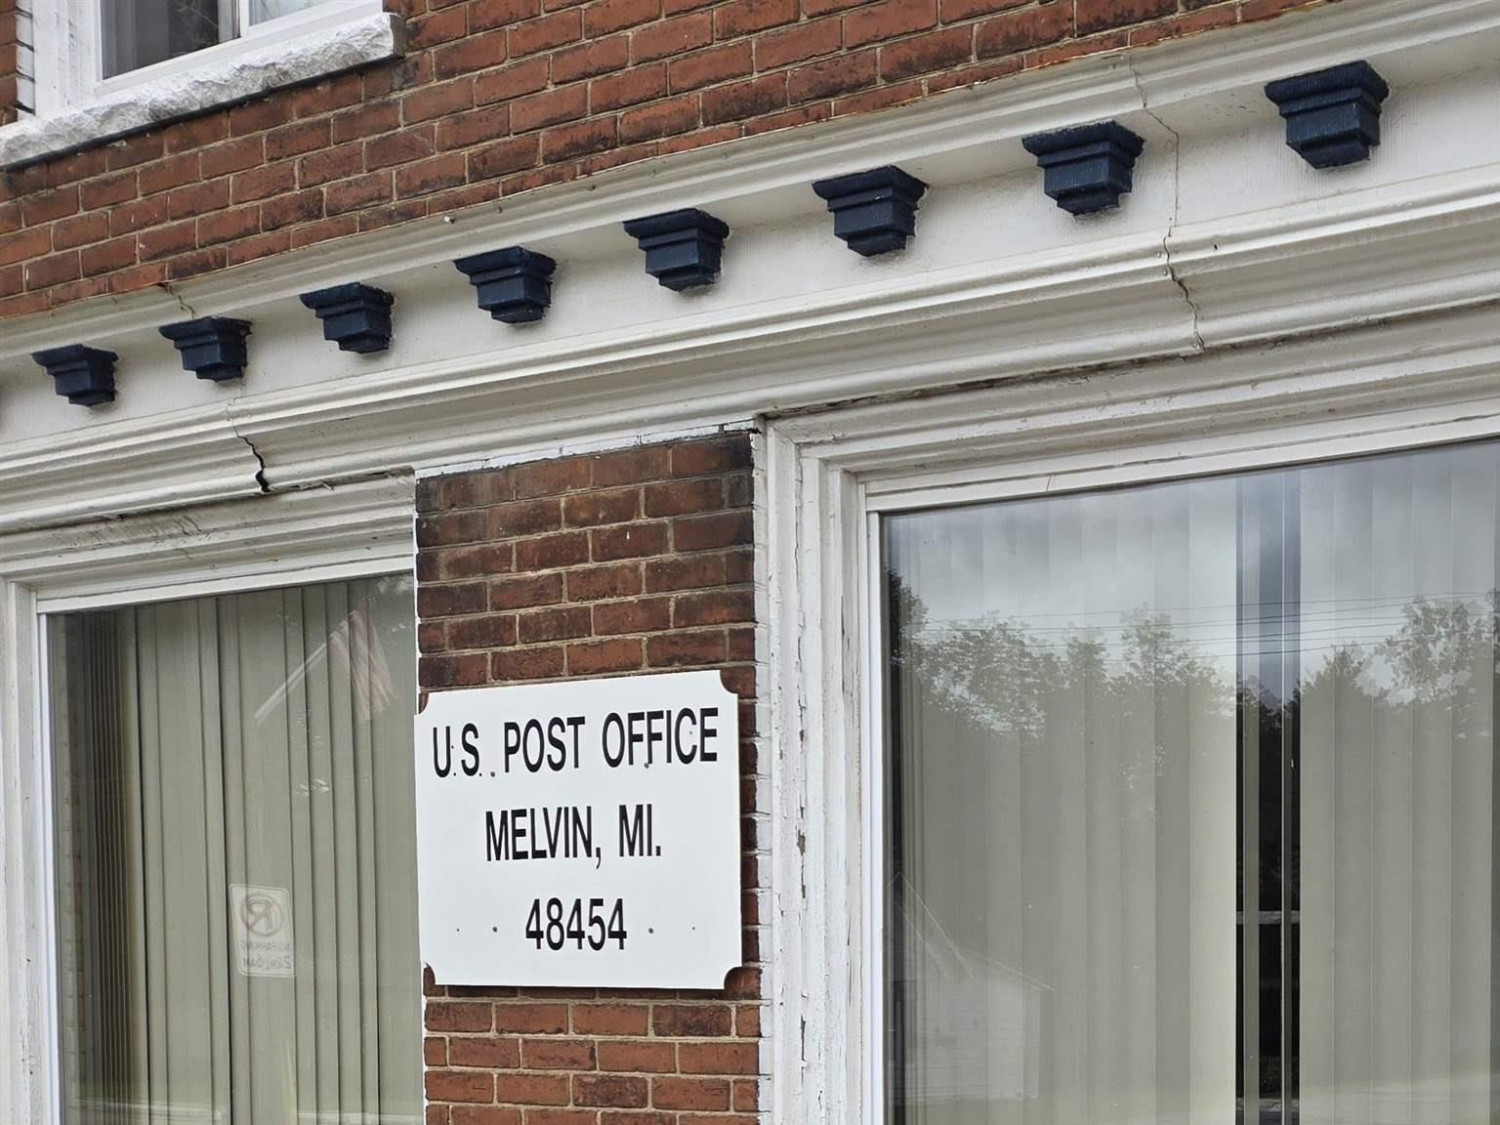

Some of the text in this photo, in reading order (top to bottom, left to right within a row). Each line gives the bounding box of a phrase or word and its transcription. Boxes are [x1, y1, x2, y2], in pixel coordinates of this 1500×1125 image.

[433, 707, 718, 777] U.S. POST OFFICE
[486, 804, 661, 869] MELVIN, MI.
[526, 897, 627, 950] 48454
